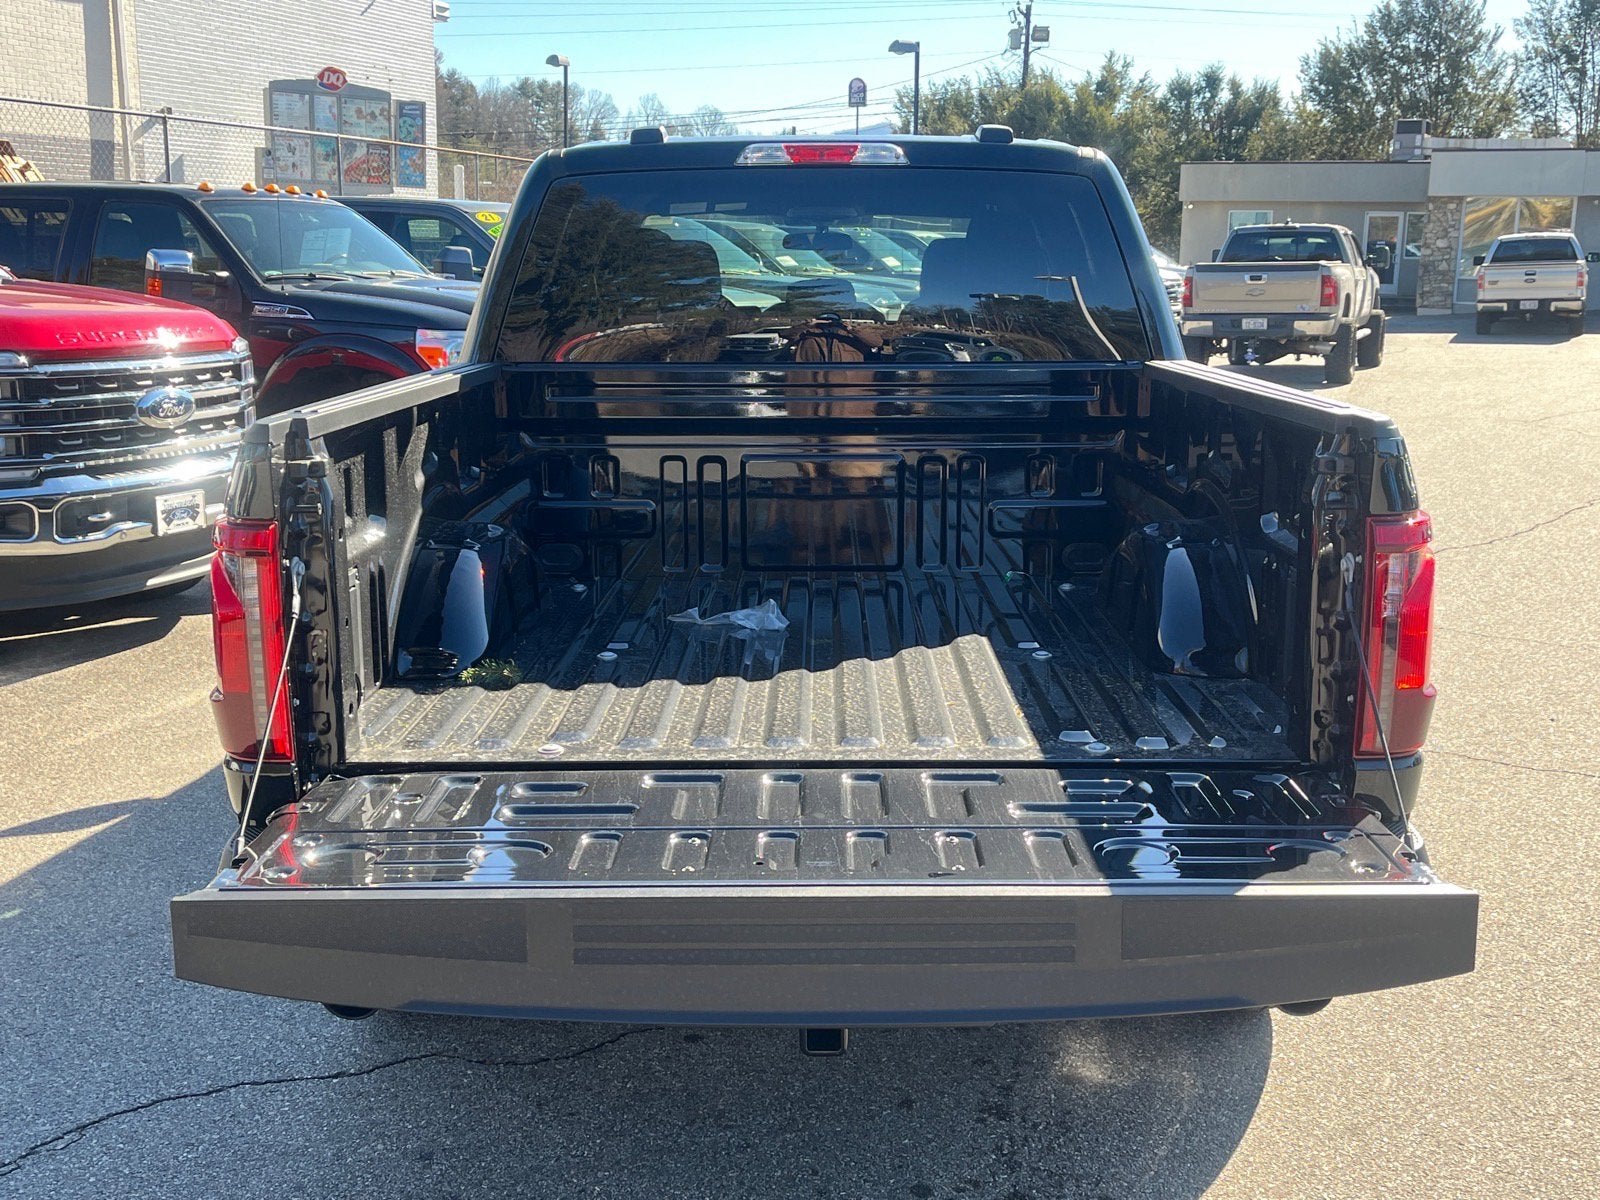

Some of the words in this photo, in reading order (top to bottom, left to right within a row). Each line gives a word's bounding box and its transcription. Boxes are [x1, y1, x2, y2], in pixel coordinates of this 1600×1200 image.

[323, 71, 343, 87] DQ
[481, 213, 496, 221] 21
[158, 399, 185, 417] Ford
